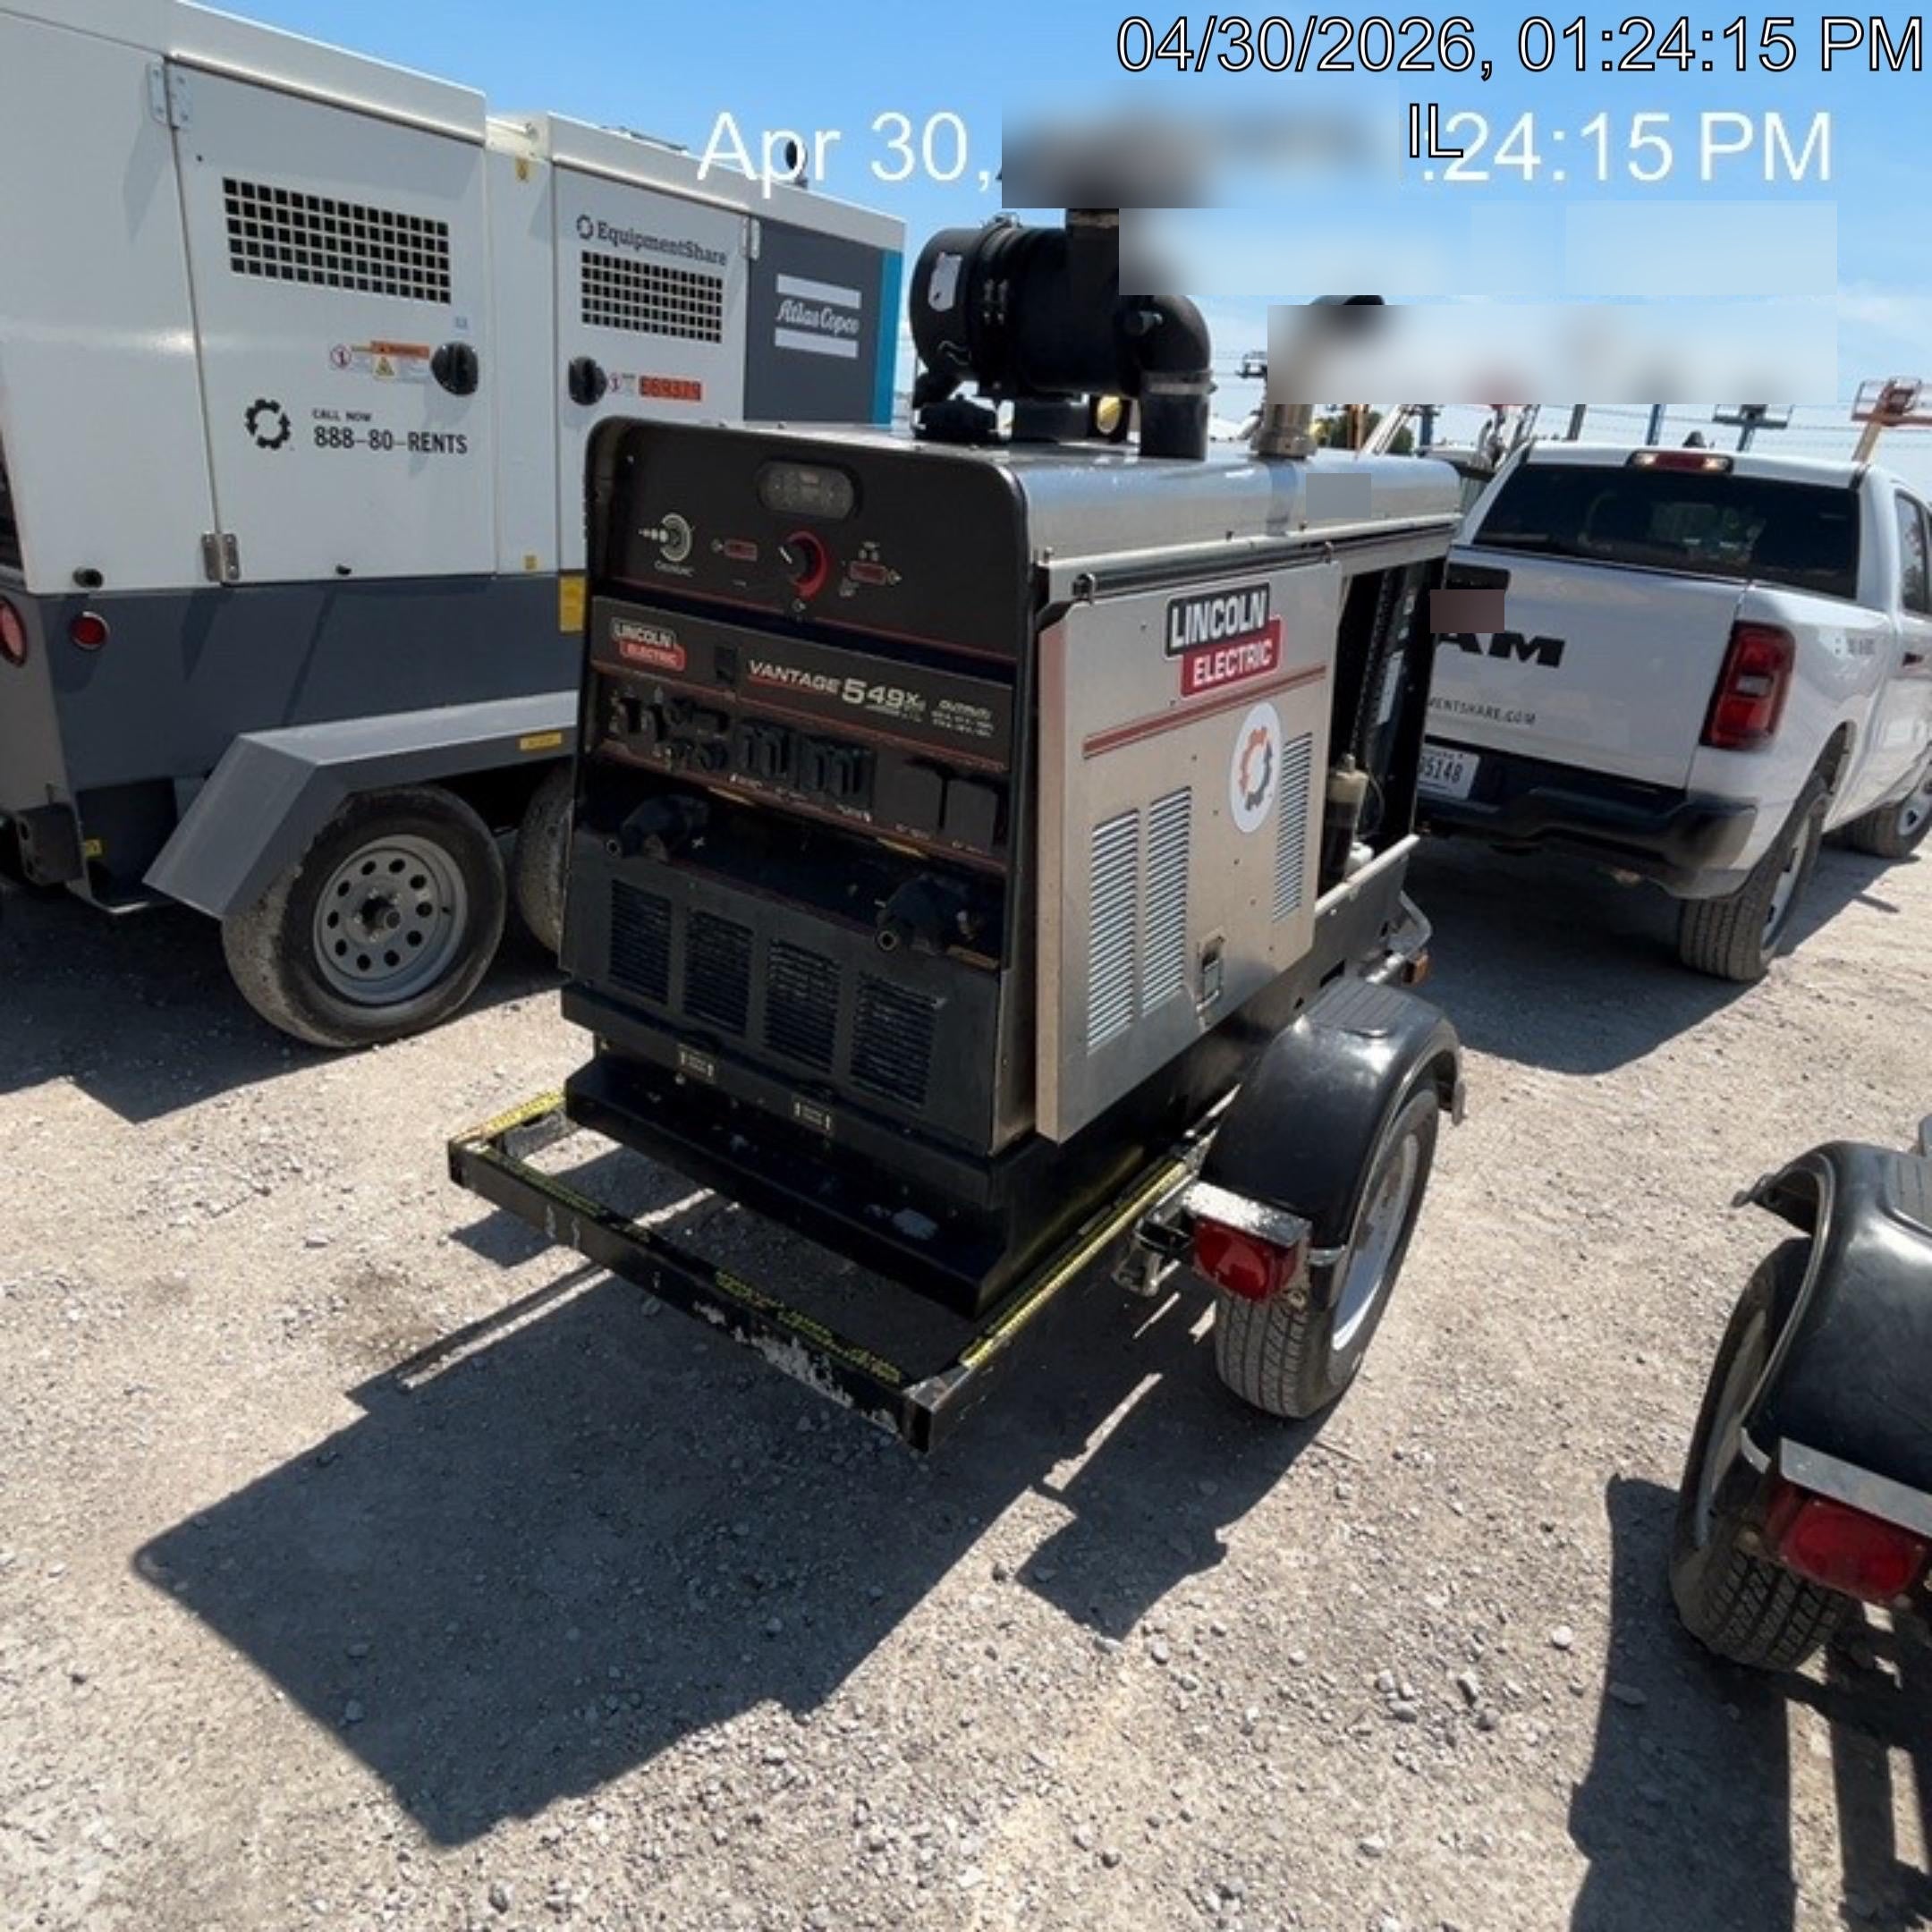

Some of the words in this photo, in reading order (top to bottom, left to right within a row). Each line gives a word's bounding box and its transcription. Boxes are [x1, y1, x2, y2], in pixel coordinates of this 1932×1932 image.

[597, 220, 727, 266] EquipmentShare
[775, 299, 819, 327] Atlas
[820, 307, 860, 336] Copco
[312, 409, 341, 421] CALL
[346, 411, 373, 422] NOW
[314, 427, 468, 454] 888-80-RENTS
[614, 621, 674, 648] LINCOLN
[1170, 589, 1267, 648] LINCOLN
[1192, 638, 1272, 688] ELECTRIC
[1433, 630, 1566, 669] AM
[750, 658, 842, 694] VANTAGE
